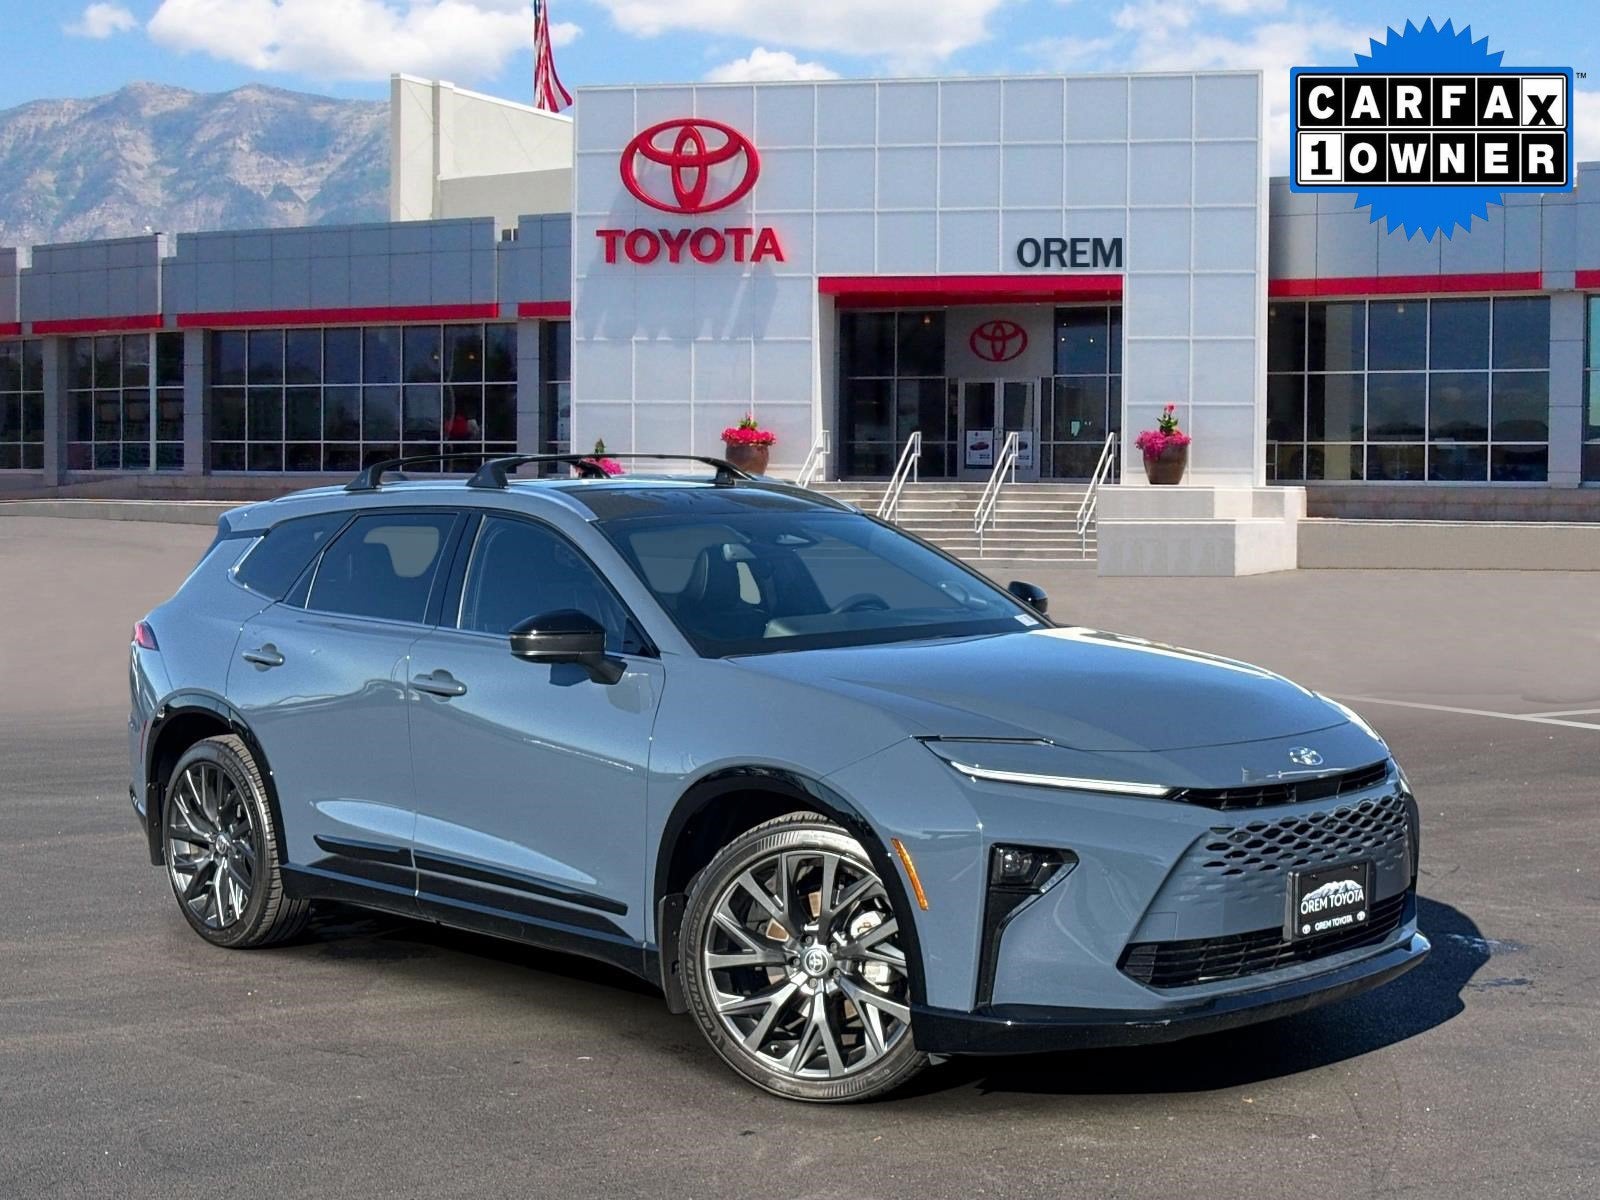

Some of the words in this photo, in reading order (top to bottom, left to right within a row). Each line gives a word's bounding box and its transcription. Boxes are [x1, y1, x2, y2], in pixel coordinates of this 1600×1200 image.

[596, 227, 784, 264] TOYOTA
[1017, 237, 1123, 268] OREM
[1301, 896, 1328, 914] OREM
[1329, 889, 1364, 908] TOYOTA
[1315, 919, 1331, 931] OREM
[1332, 915, 1353, 927] TOYOTA
[685, 958, 715, 1032] MICHELIN
